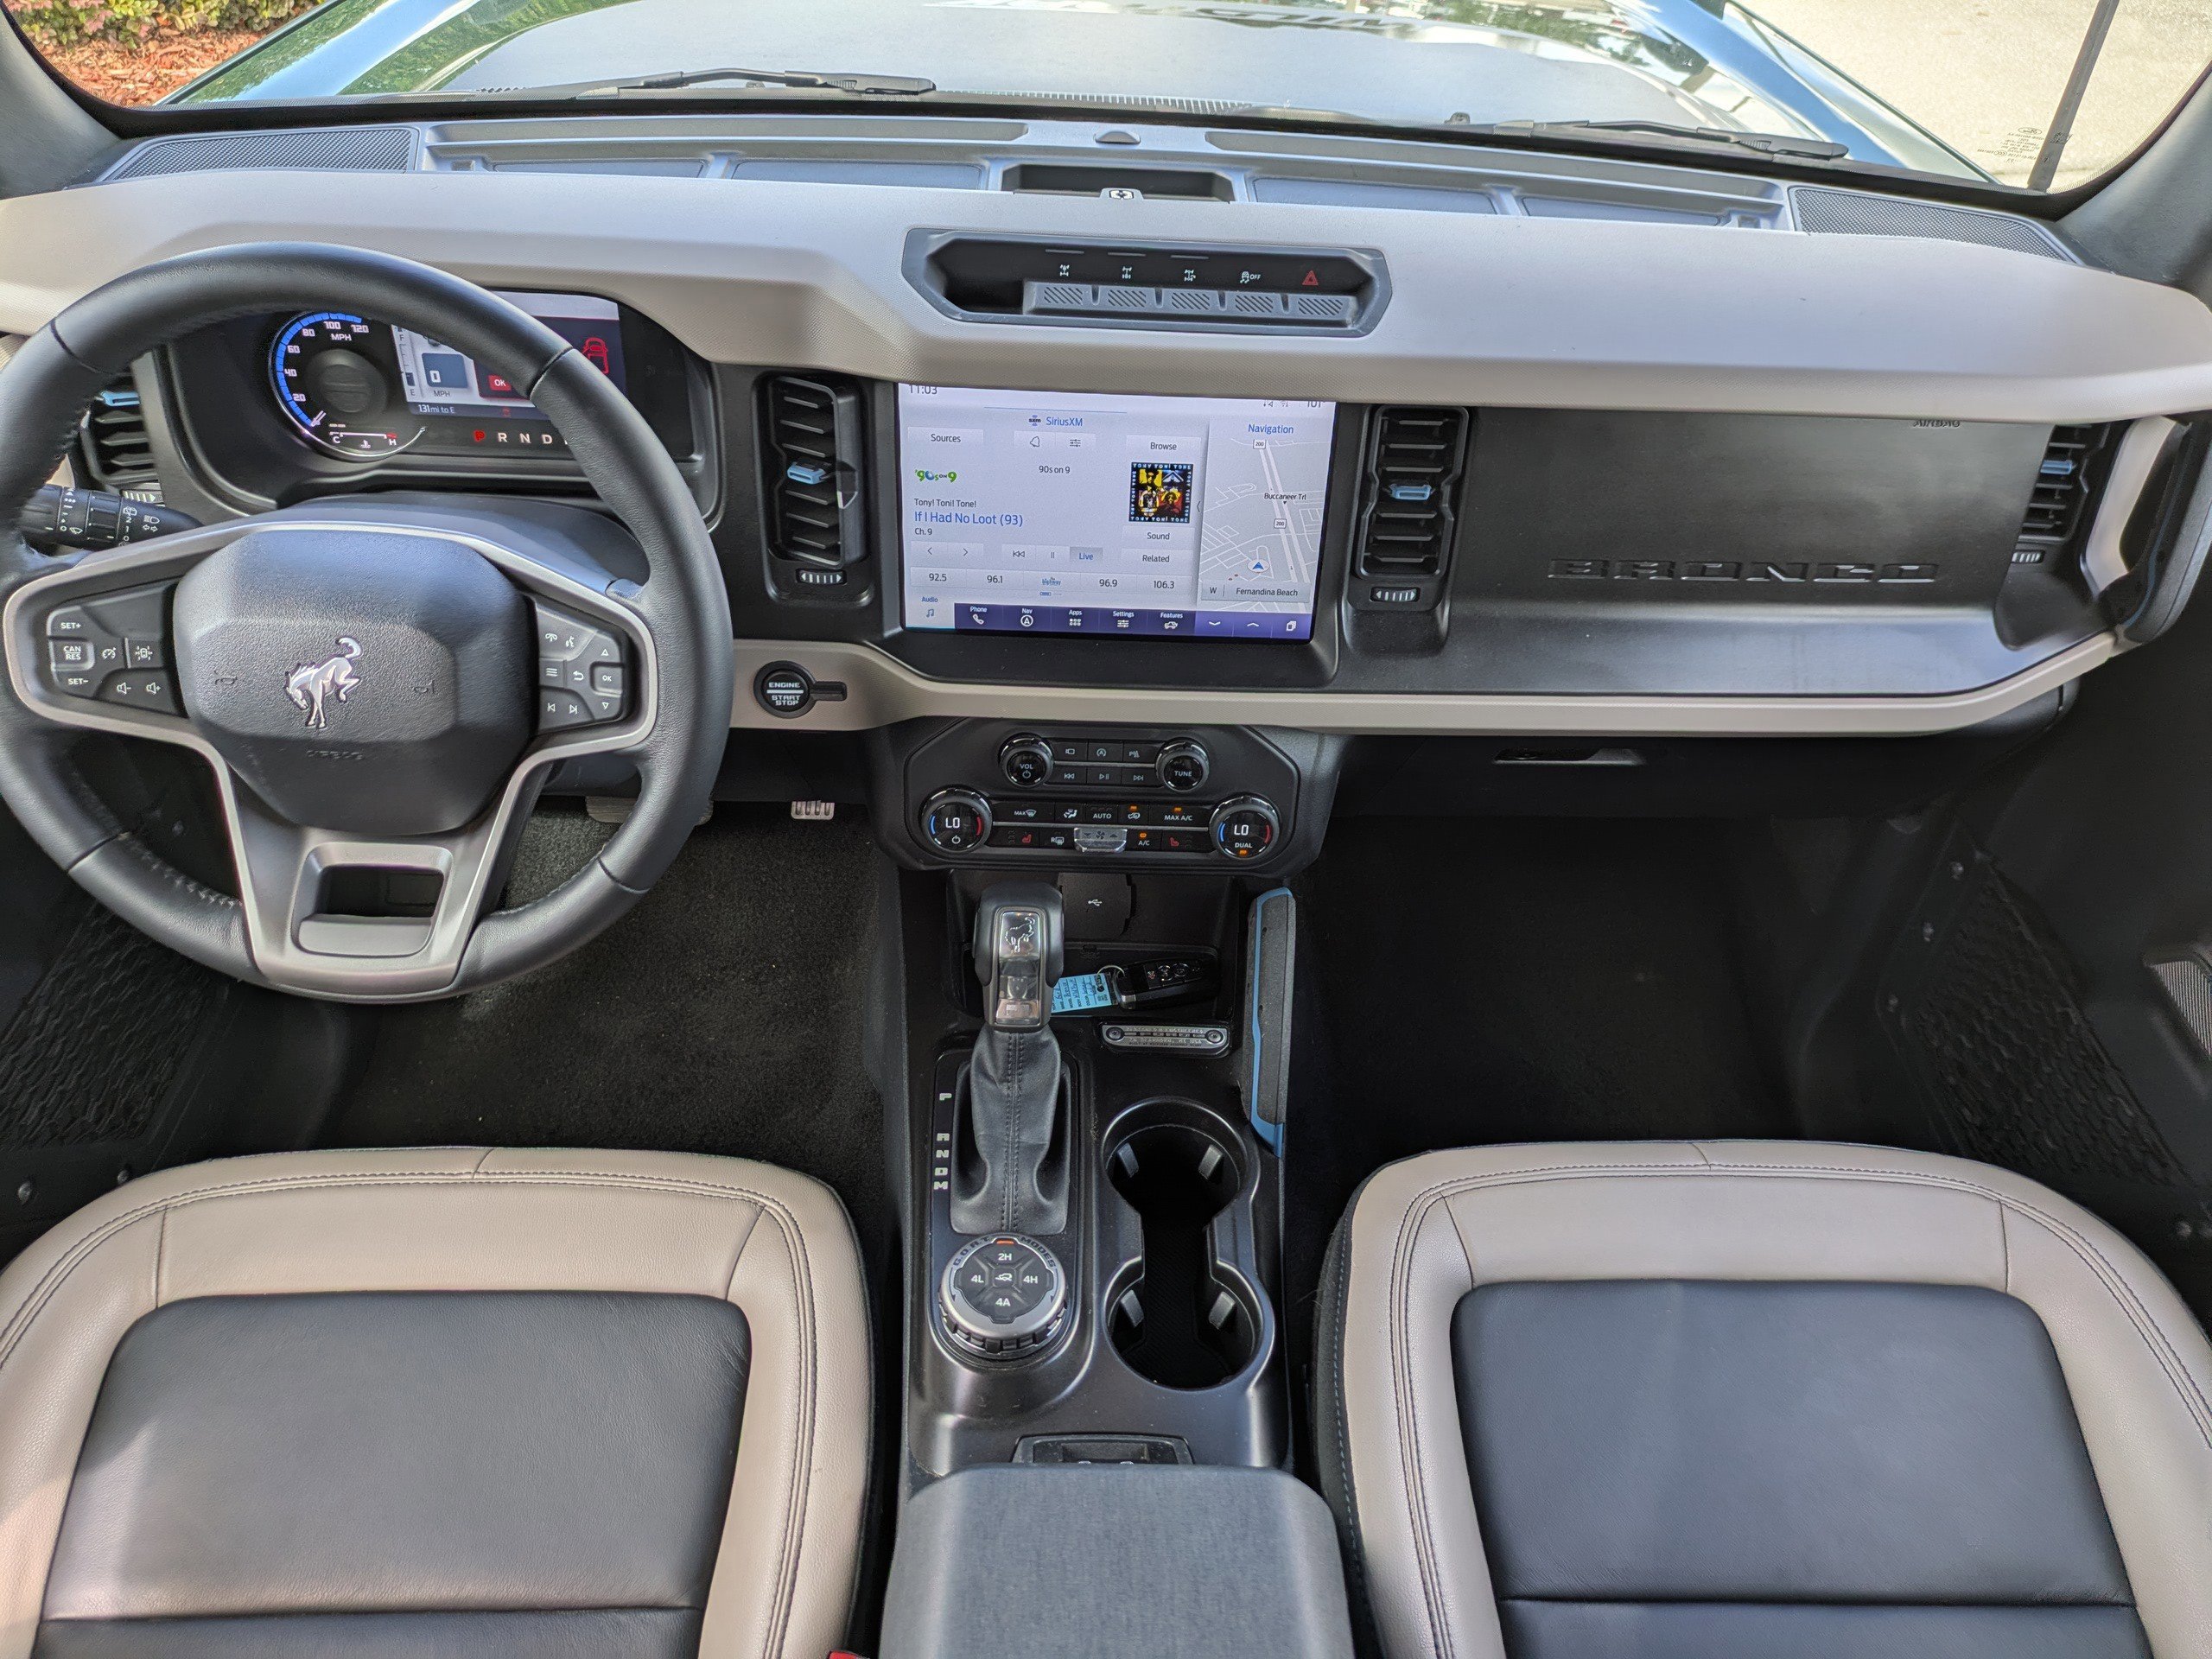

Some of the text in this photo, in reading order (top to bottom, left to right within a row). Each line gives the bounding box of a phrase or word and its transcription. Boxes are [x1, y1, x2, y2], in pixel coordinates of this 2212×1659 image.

[323, 321, 341, 330] 100
[351, 324, 369, 334] 120
[302, 328, 315, 337] 80
[287, 345, 301, 354] 60
[284, 368, 298, 377] 40
[494, 378, 508, 388] OK
[410, 388, 416, 397] E
[292, 393, 306, 402] 20
[1046, 416, 1084, 427] SiriusXM
[1248, 423, 1294, 435] Navigation
[333, 435, 341, 444] C
[498, 432, 508, 442] R
[519, 433, 531, 443] N
[542, 434, 553, 445] D
[931, 433, 962, 443] Sources
[1150, 442, 1178, 451] Browse
[1039, 465, 1053, 474] 90s
[1065, 466, 1071, 474] 9
[948, 471, 957, 483] 9
[914, 498, 977, 508] Tony! Toni! Tone!
[914, 512, 925, 522] If
[930, 512, 952, 523] Had
[955, 512, 969, 524] No
[972, 513, 997, 524] Loot
[1000, 514, 1023, 527] (93)
[914, 527, 926, 536] Ch.
[1147, 531, 1170, 540] Sound
[1079, 552, 1094, 561] Live
[1142, 554, 1170, 563] Related
[1547, 558, 1939, 583] BRONCO
[928, 573, 947, 582] 92.5
[987, 575, 1003, 584] 96.1
[1099, 578, 1118, 588] 96.9
[1153, 580, 1175, 590] 106.3
[1210, 586, 1217, 594] W
[1236, 587, 1298, 596] Fernandina Beach
[1112, 610, 1135, 619] Settings
[945, 817, 961, 829] LO
[1234, 824, 1249, 836] LO
[938, 1092, 952, 1101] P
[937, 1133, 950, 1141] R
[936, 1149, 950, 1158] N
[934, 1167, 949, 1176] D
[933, 1180, 949, 1190] M
[998, 1252, 1012, 1261] 2H
[1020, 1236, 1057, 1268] MODES
[970, 1274, 984, 1283] 4L
[1023, 1274, 1039, 1284] 4H
[995, 1298, 1011, 1306] 4A
